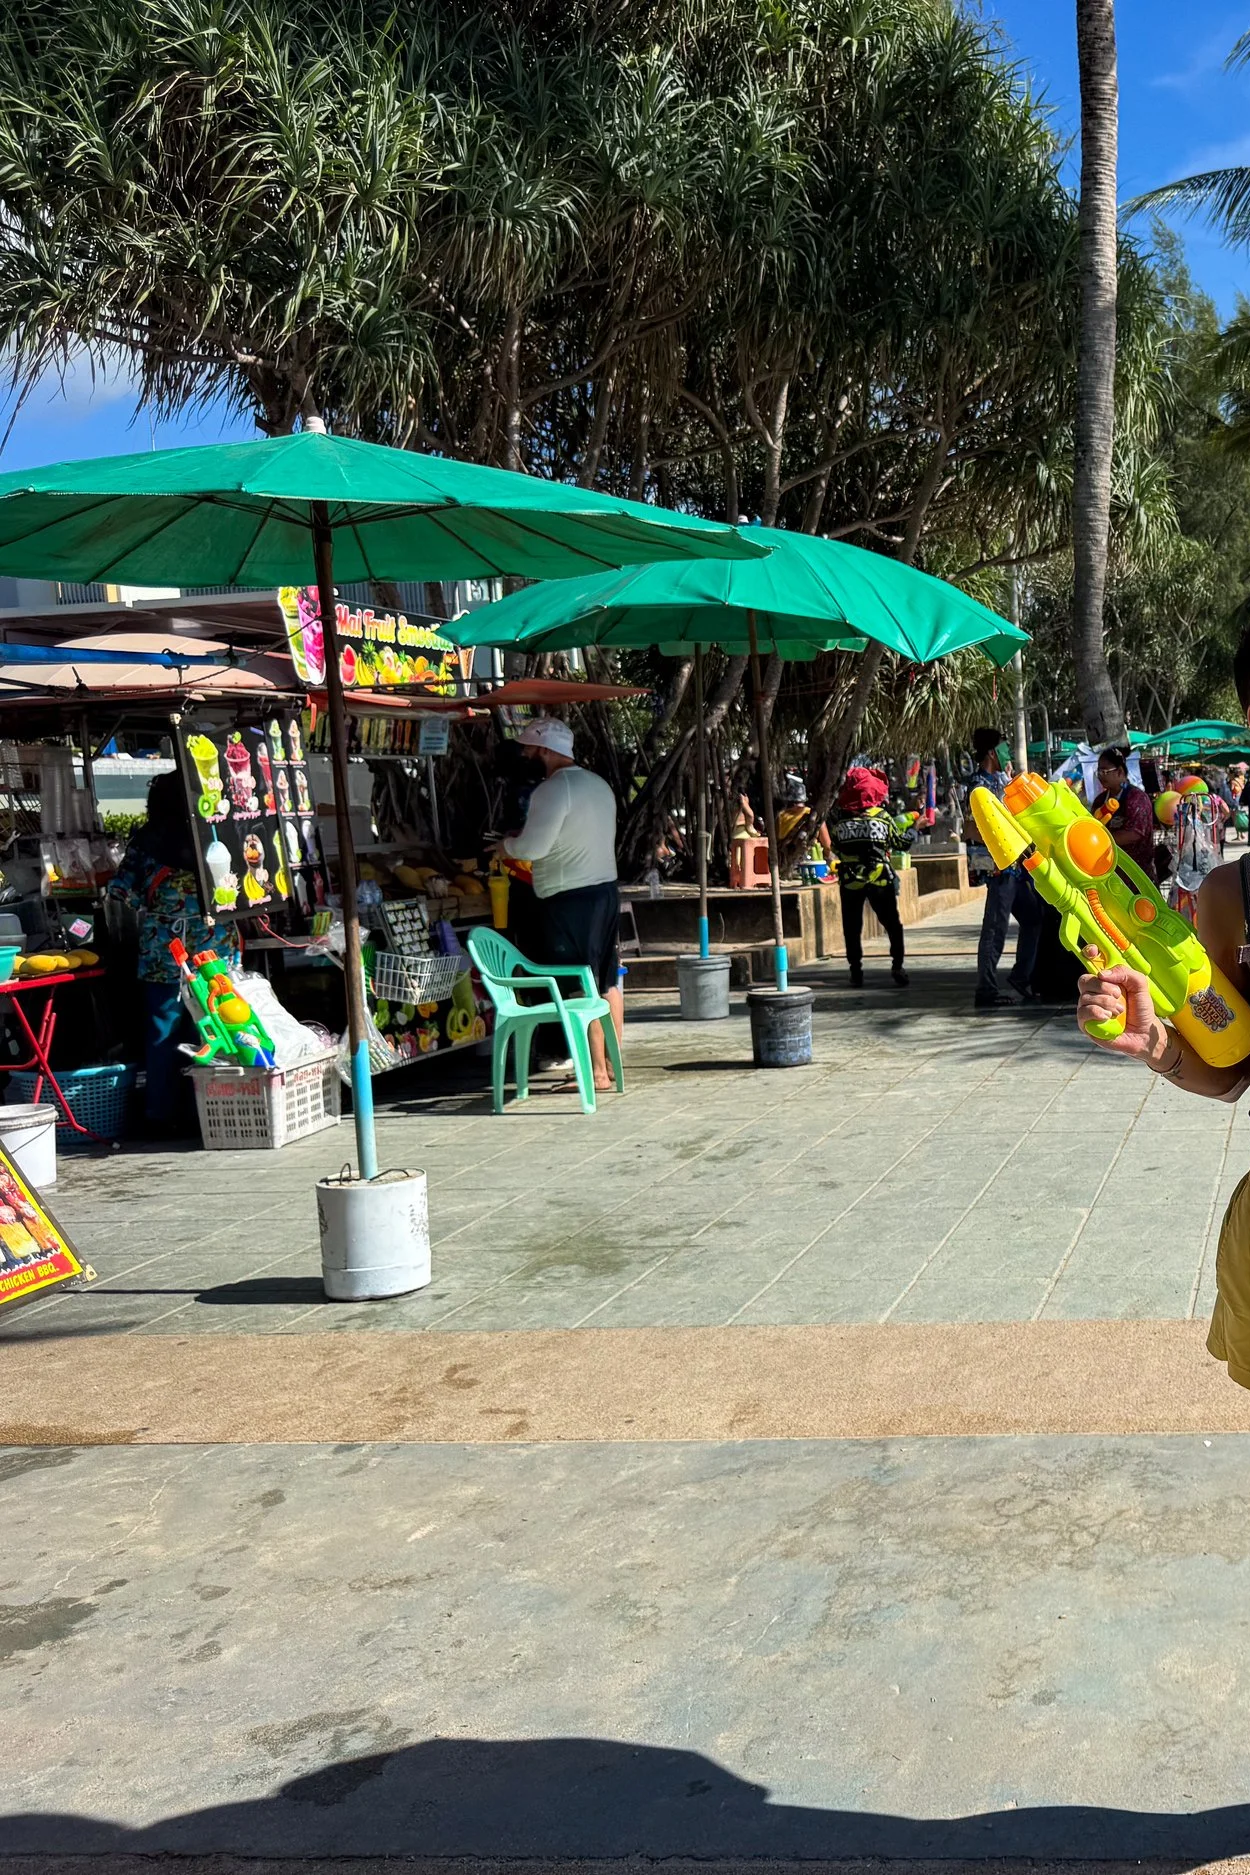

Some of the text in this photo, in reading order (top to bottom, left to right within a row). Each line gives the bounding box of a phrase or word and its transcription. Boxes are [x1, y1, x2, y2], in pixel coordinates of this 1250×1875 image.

[363, 609, 396, 643] Fruit
[1195, 1004, 1214, 1026] GUN
[1199, 995, 1225, 1025] WATER
[0, 1269, 35, 1292] CHICKEN
